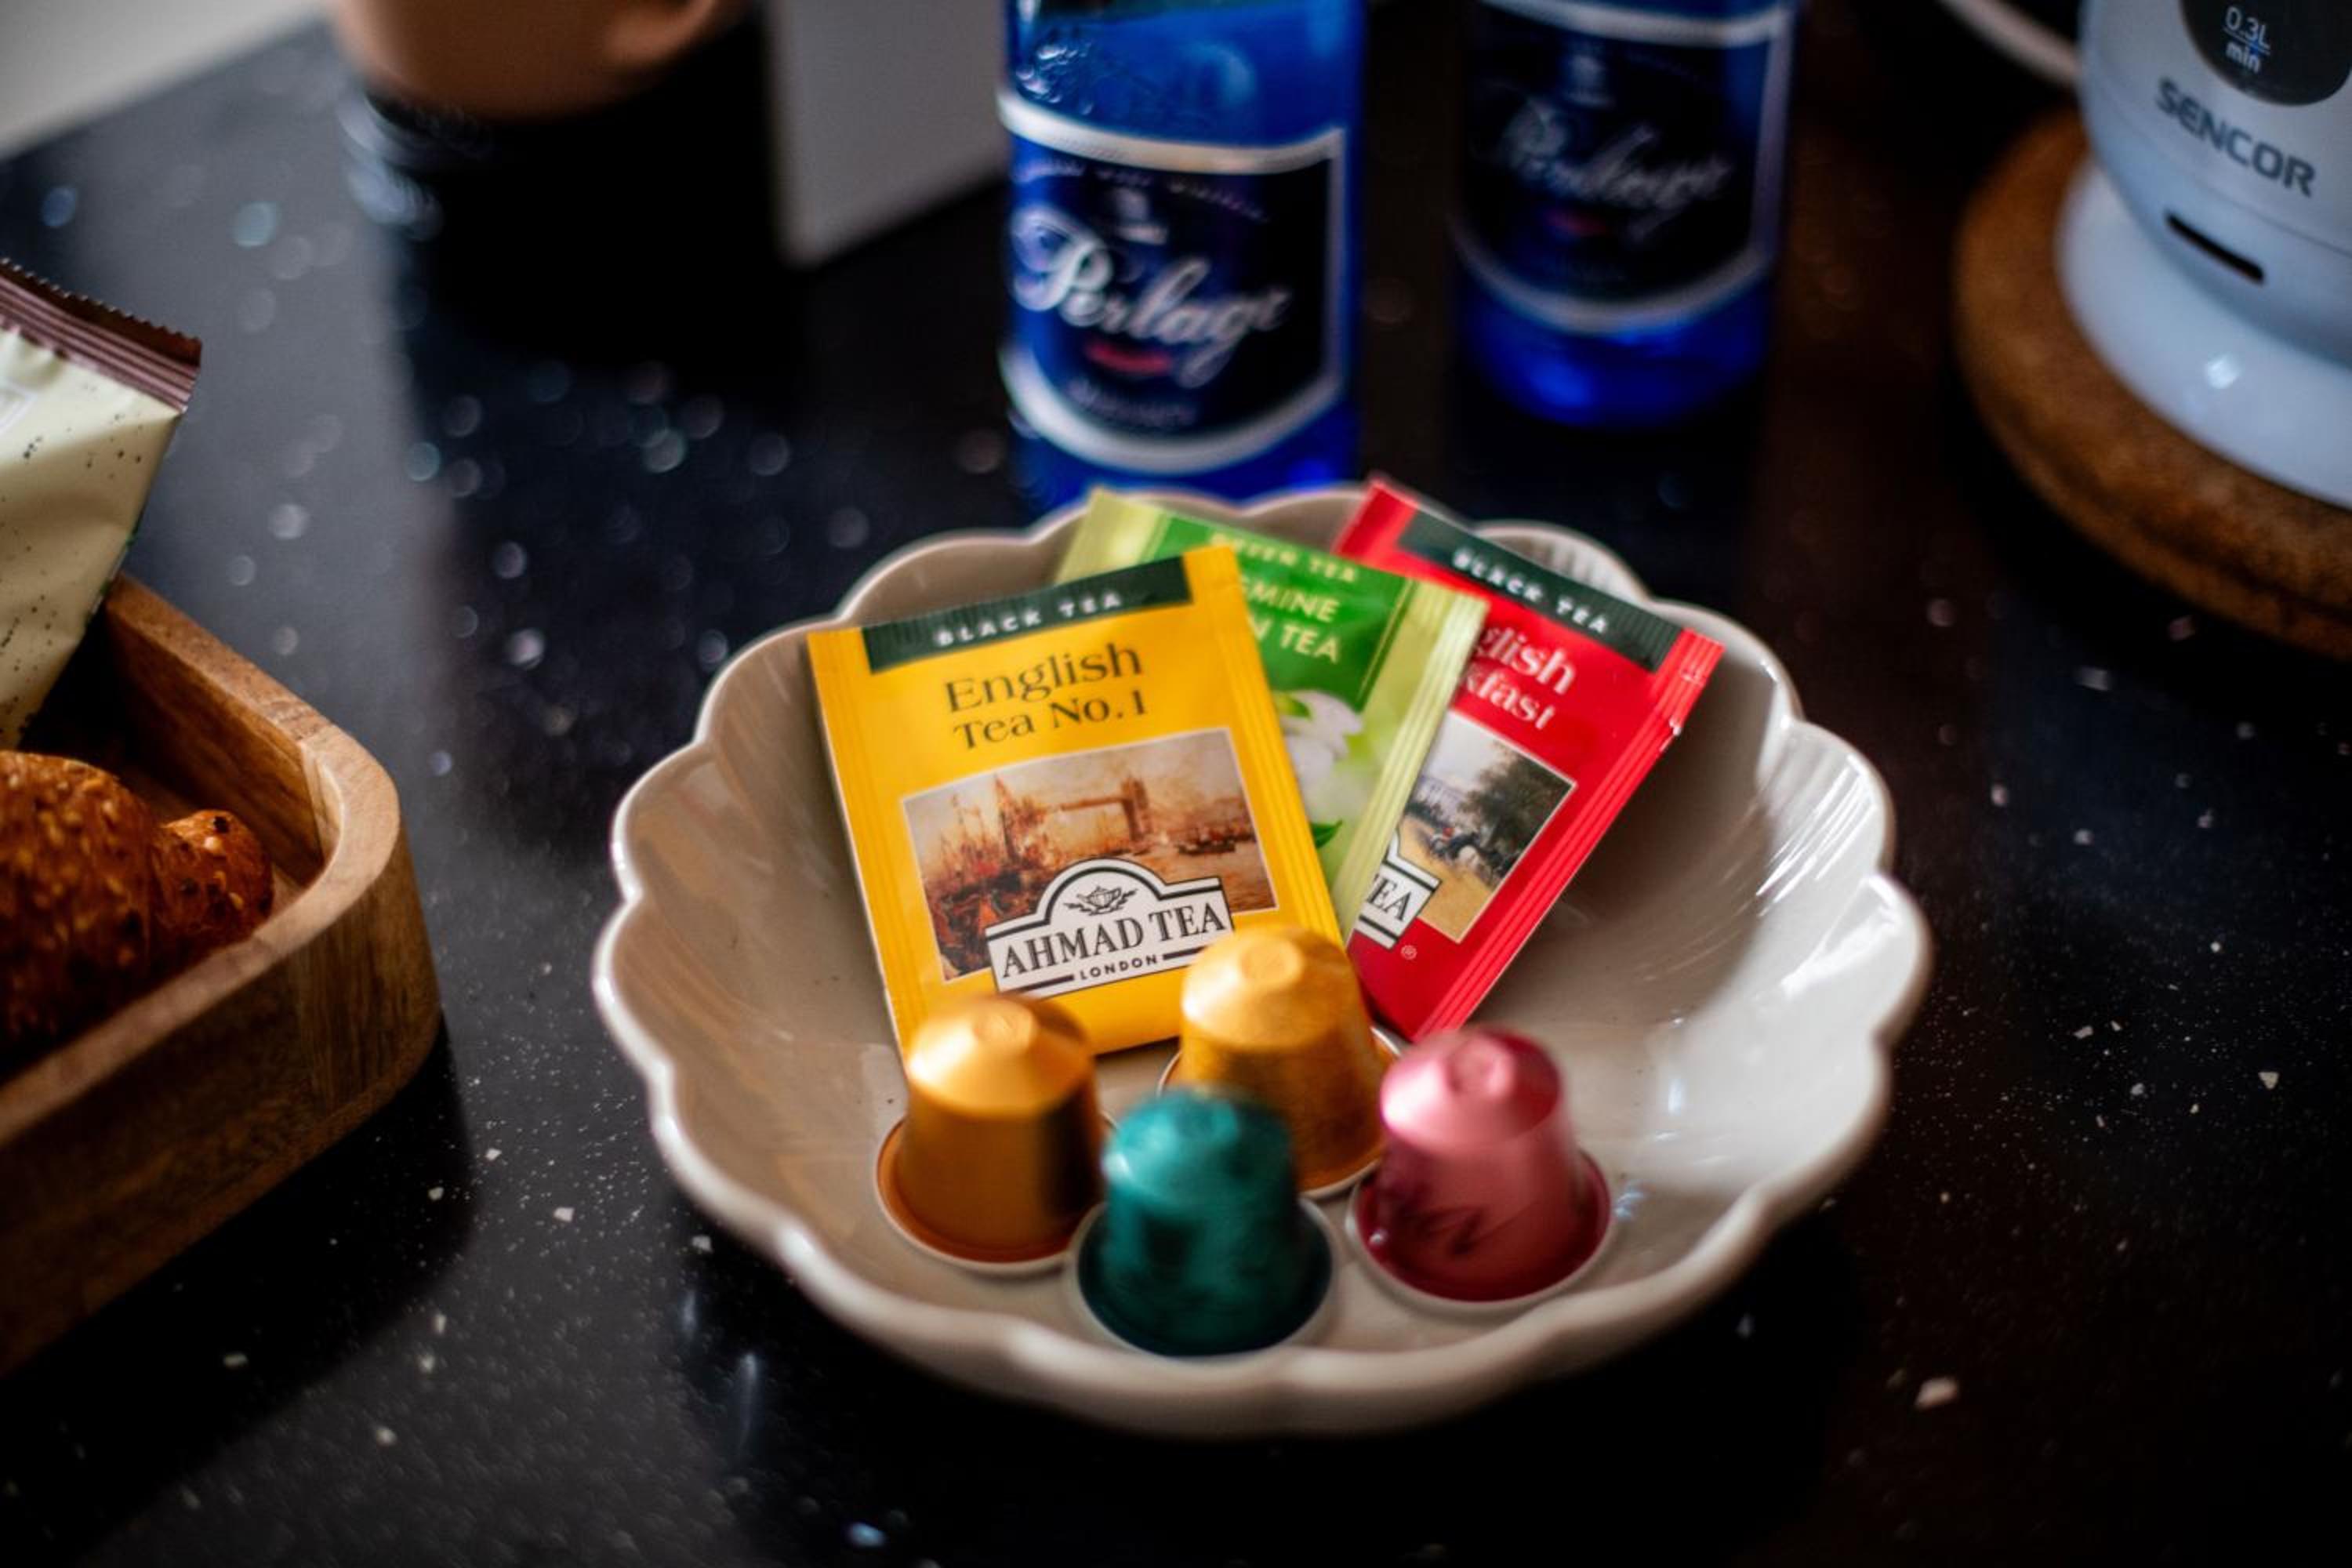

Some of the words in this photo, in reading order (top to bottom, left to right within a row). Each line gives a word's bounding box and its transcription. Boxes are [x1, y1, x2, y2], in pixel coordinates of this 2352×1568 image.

[2225, 6, 2270, 49] 0.3L
[2225, 42, 2261, 74] min
[2157, 77, 2316, 198] SENCOR
[1309, 557, 1356, 582] TEA
[1453, 548, 1544, 603] BLACK
[1556, 596, 1606, 633] TEA
[933, 608, 1042, 647] BLACK
[1058, 592, 1121, 618] TEA
[1280, 623, 1339, 663] TEA
[945, 642, 1143, 713] English
[953, 713, 1036, 749] Tea
[1367, 873, 1412, 921] EA
[1002, 916, 1144, 978] AHMAD
[1148, 902, 1226, 942] TEA
[1080, 953, 1157, 980] LONDON
